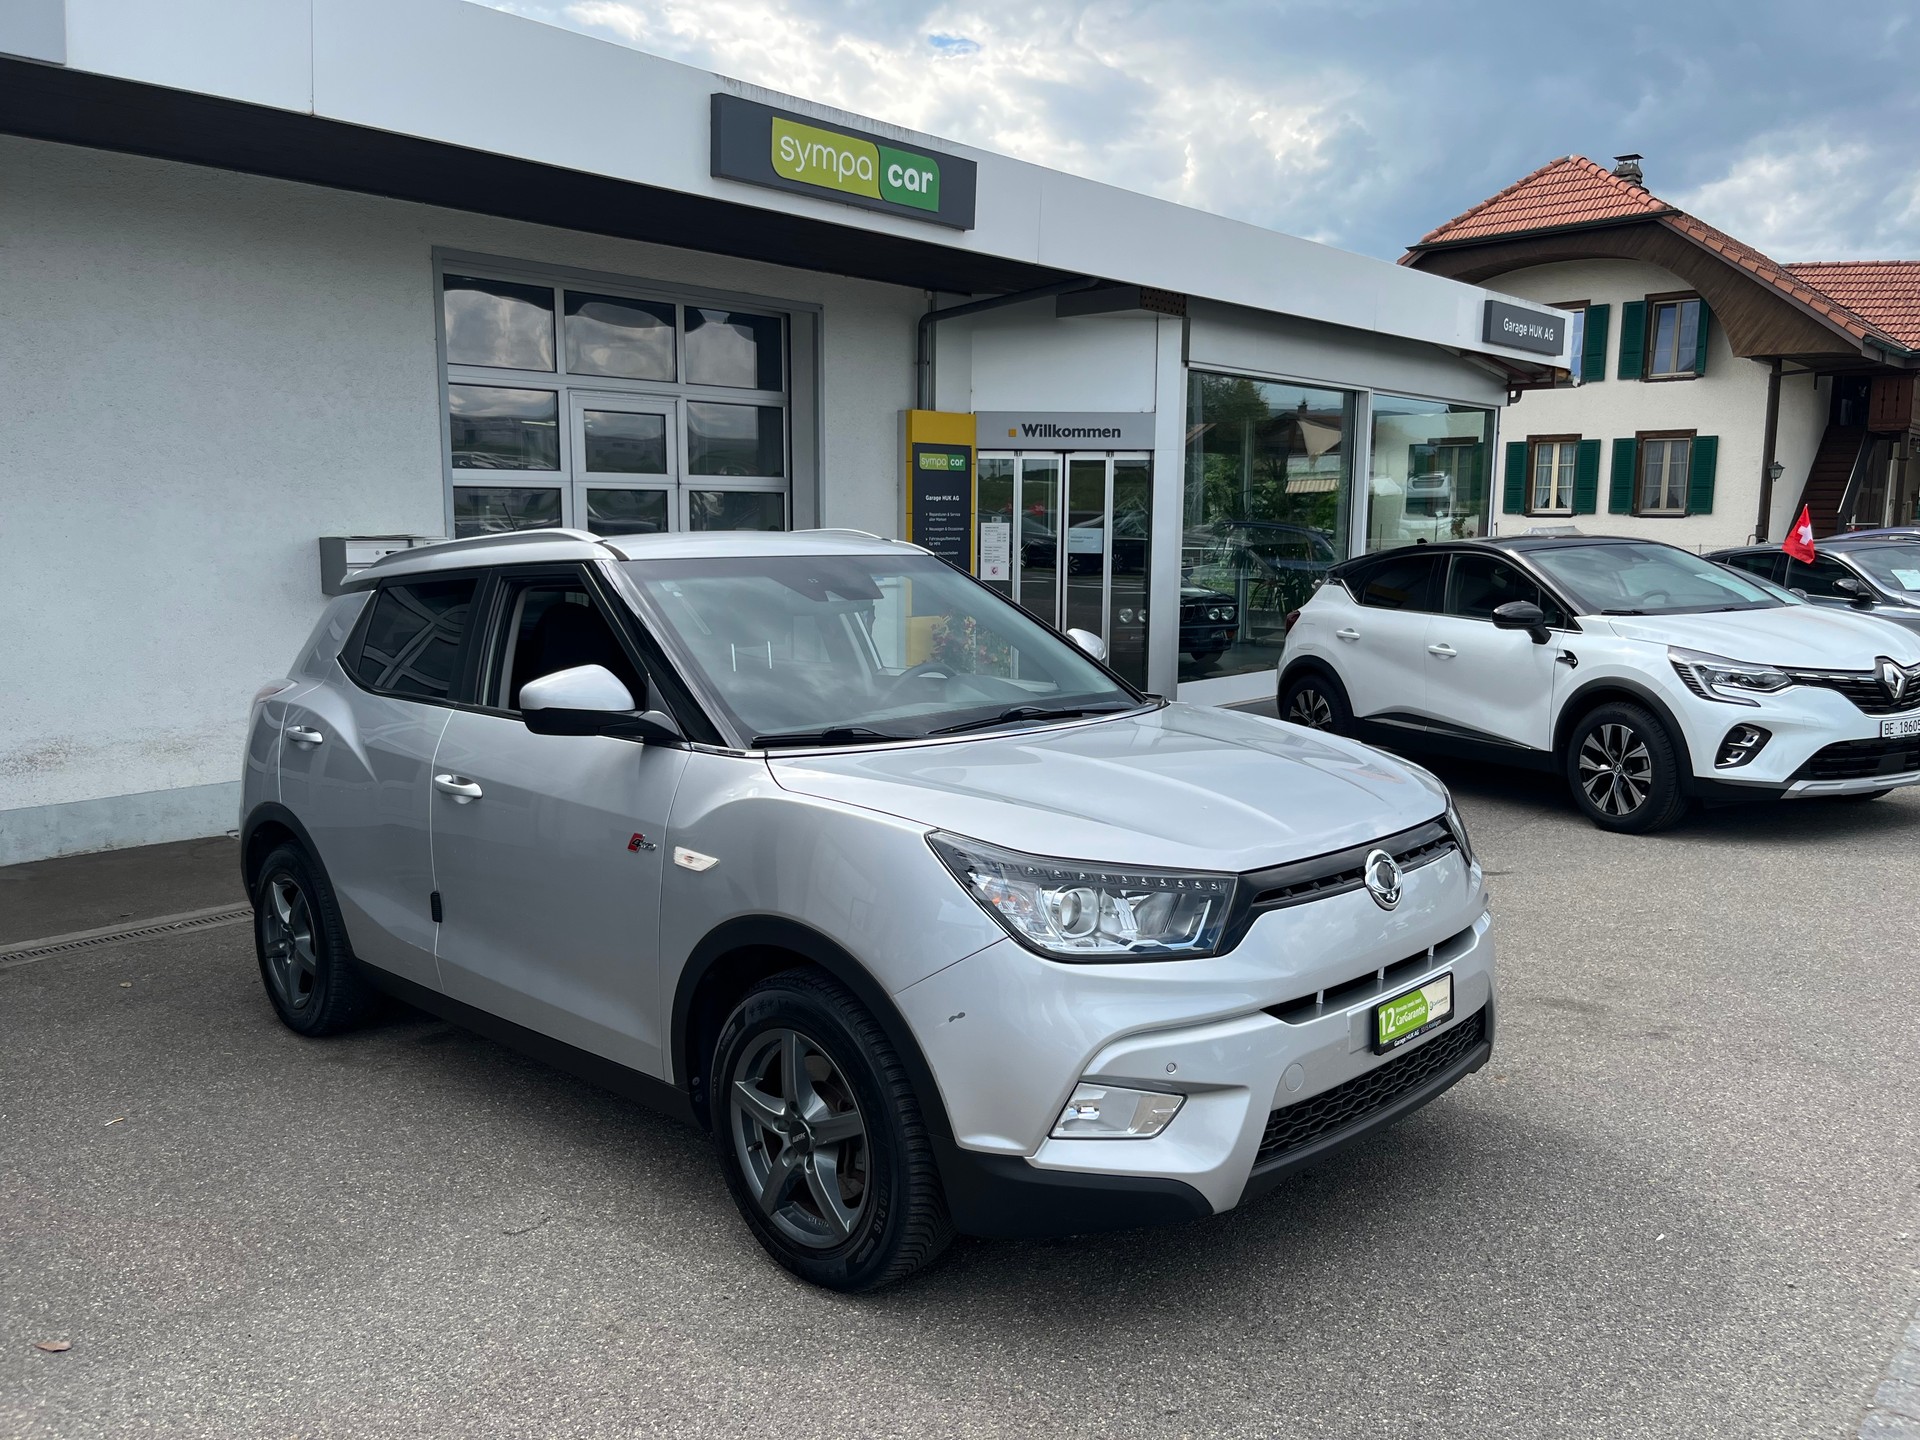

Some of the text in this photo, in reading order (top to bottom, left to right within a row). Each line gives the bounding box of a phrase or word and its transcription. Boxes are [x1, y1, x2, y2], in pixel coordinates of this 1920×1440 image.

[780, 135, 934, 194] sympa car
[1503, 317, 1554, 341] Garage HUK AG
[1021, 423, 1121, 438] Willkommen
[921, 457, 964, 468] sympa car
[925, 494, 941, 502] Garage
[1885, 723, 1894, 735] BE
[1380, 1007, 1396, 1036] 12
[1396, 1005, 1426, 1026] CarGarantie
[1394, 1037, 1406, 1046] Garage
